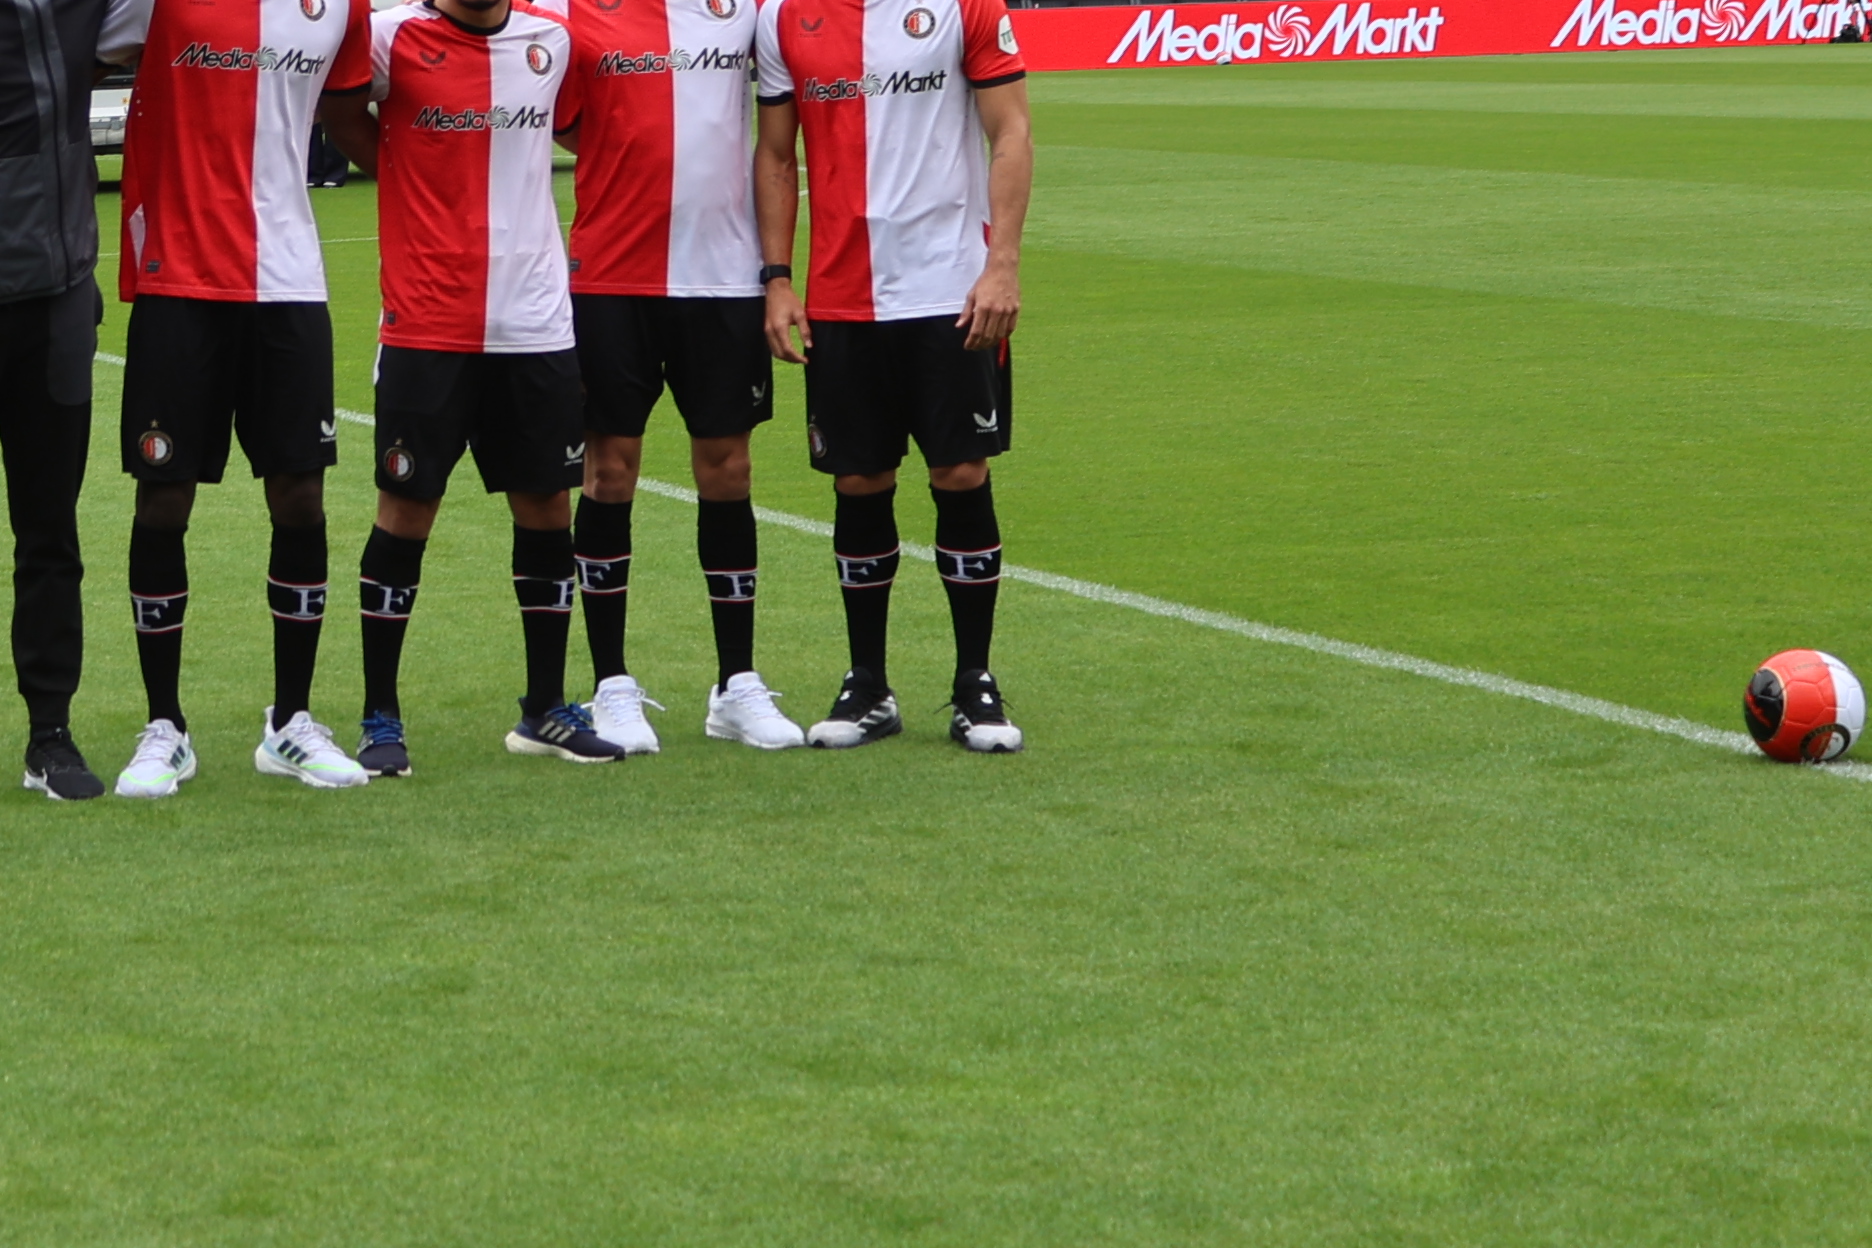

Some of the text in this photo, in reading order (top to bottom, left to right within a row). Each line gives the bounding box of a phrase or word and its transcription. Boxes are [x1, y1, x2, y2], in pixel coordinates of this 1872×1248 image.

[1107, 2, 1445, 64] Media Markt
[172, 42, 257, 71] Media
[596, 50, 668, 78] Media
[880, 69, 947, 95] Markt
[413, 106, 486, 130] Media
